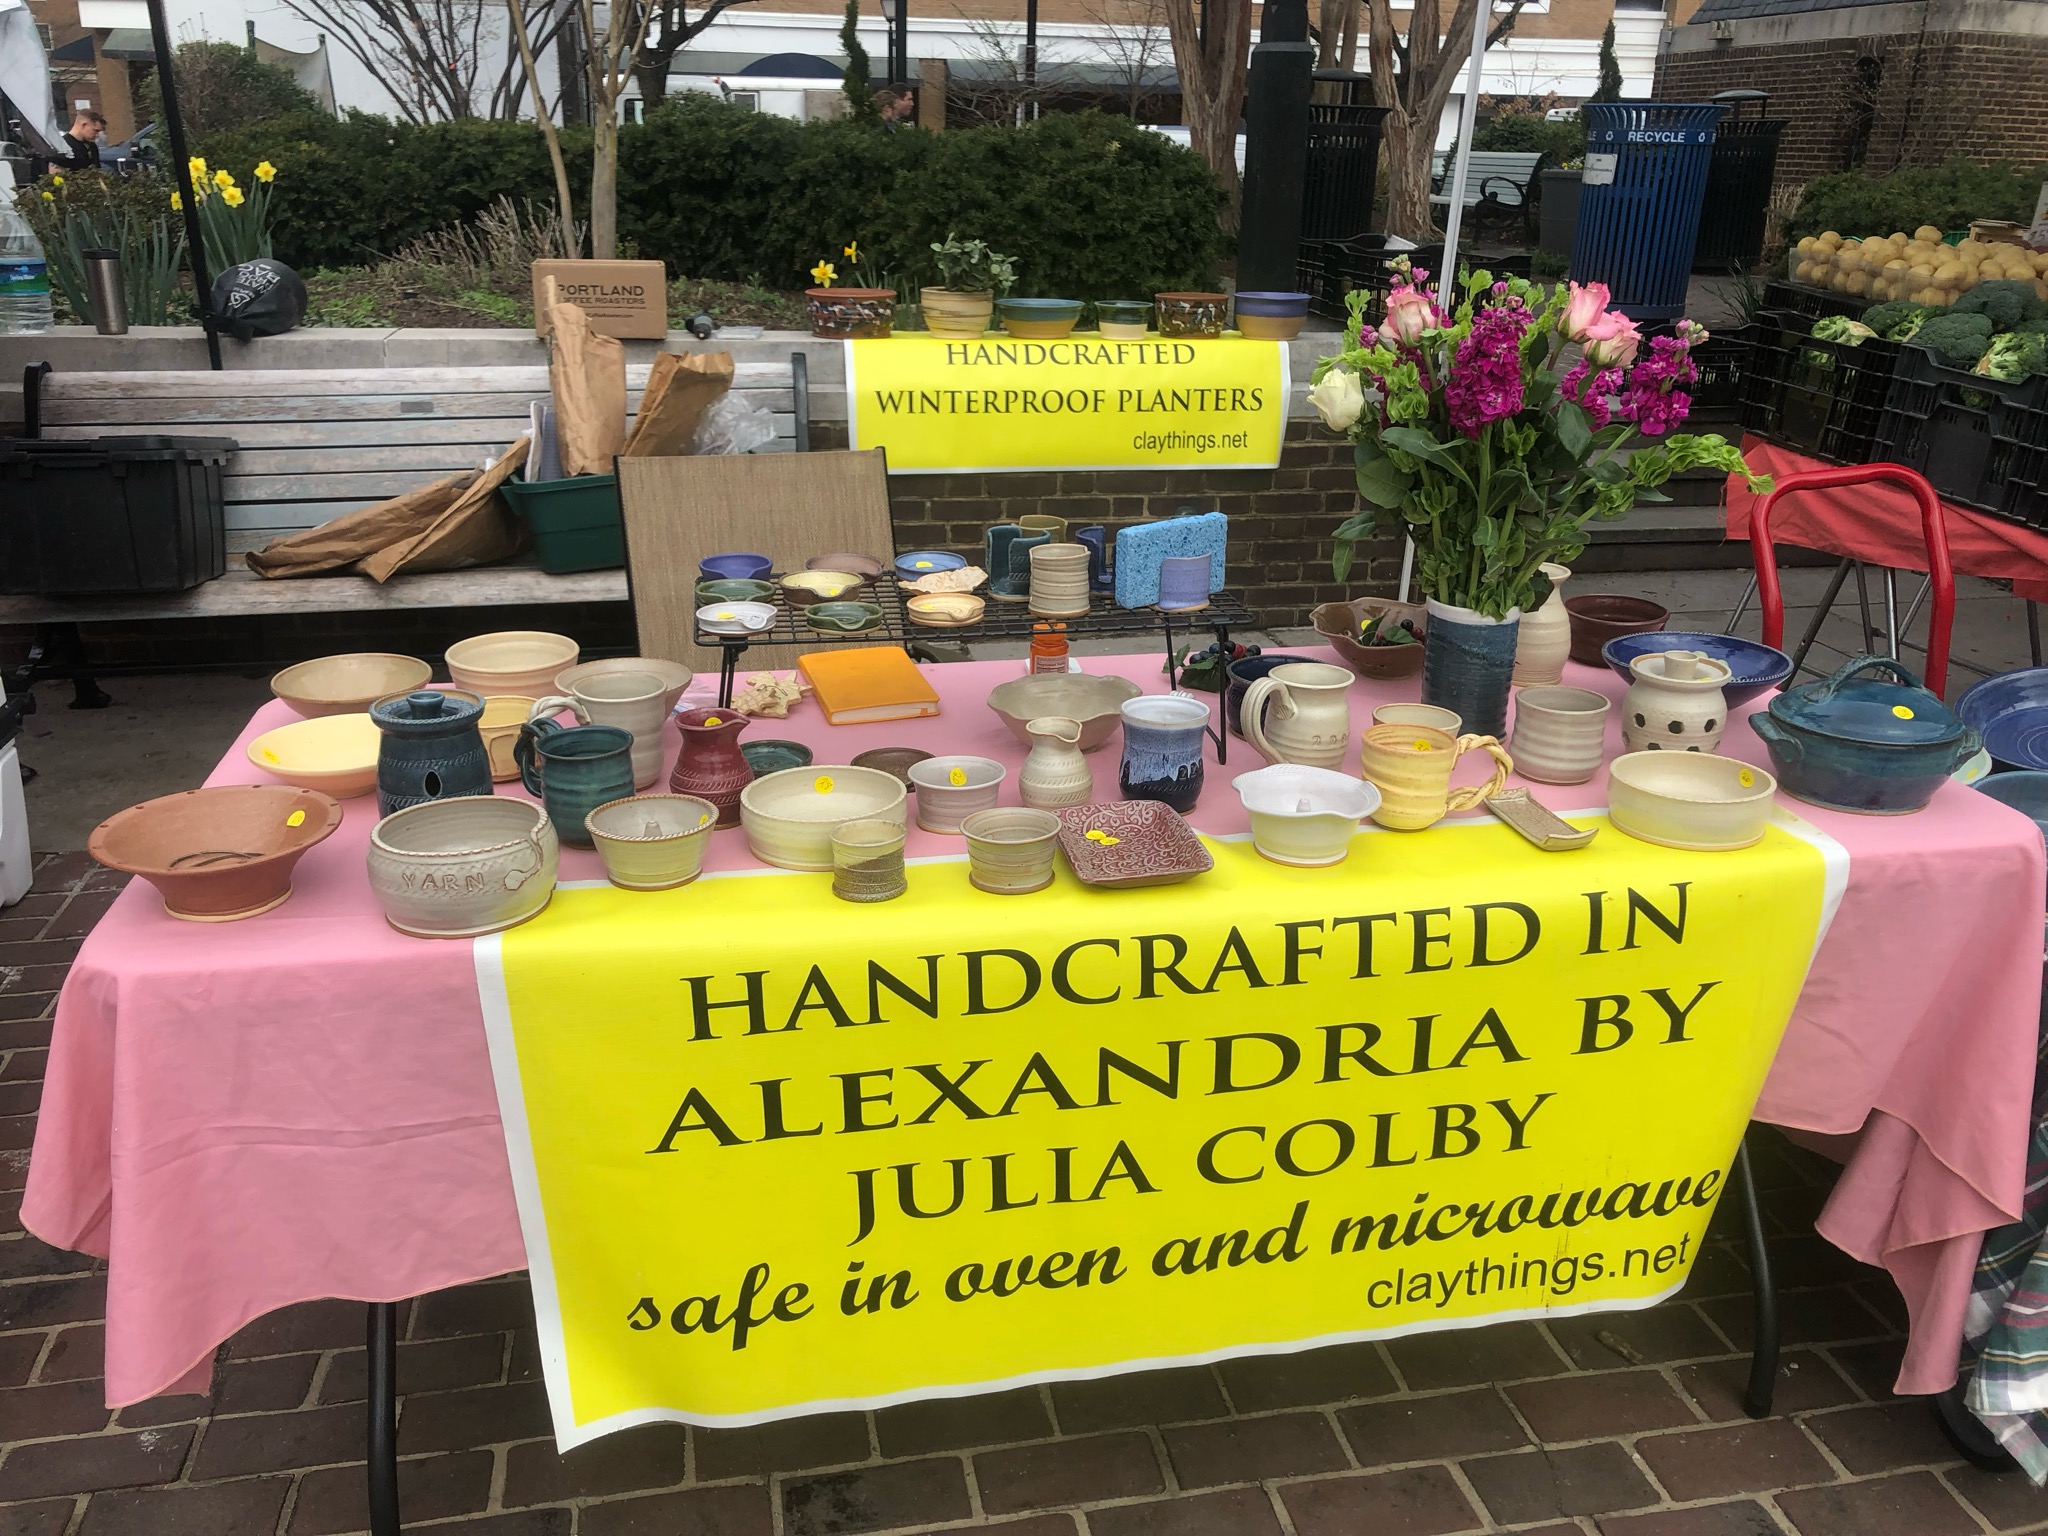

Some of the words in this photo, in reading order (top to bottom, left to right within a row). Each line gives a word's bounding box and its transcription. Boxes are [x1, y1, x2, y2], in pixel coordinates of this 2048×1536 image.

[1627, 131, 1686, 143] RECYCLE
[594, 297, 646, 305] ROASTERS
[945, 342, 1196, 365] HANDCRAFTED
[875, 388, 1105, 414] WINTERPROOF
[1117, 387, 1264, 413] PLANTERS
[1132, 430, 1249, 455] claythings.net
[402, 872, 486, 891] YARN
[680, 902, 1541, 1042] HANDCRAFTED
[1581, 881, 1692, 955] IN
[645, 1007, 1531, 1155] ALEXANDRIA
[1571, 980, 1722, 1055] BY
[847, 1139, 1162, 1247] JULIA
[1196, 1092, 1558, 1184] COLBY
[627, 1262, 815, 1352] safe
[840, 1261, 919, 1317] in
[945, 1246, 1128, 1303] oven
[1151, 1200, 1309, 1278] and
[1330, 1168, 1722, 1255] microwave
[1366, 1232, 1691, 1309] claythings.net
